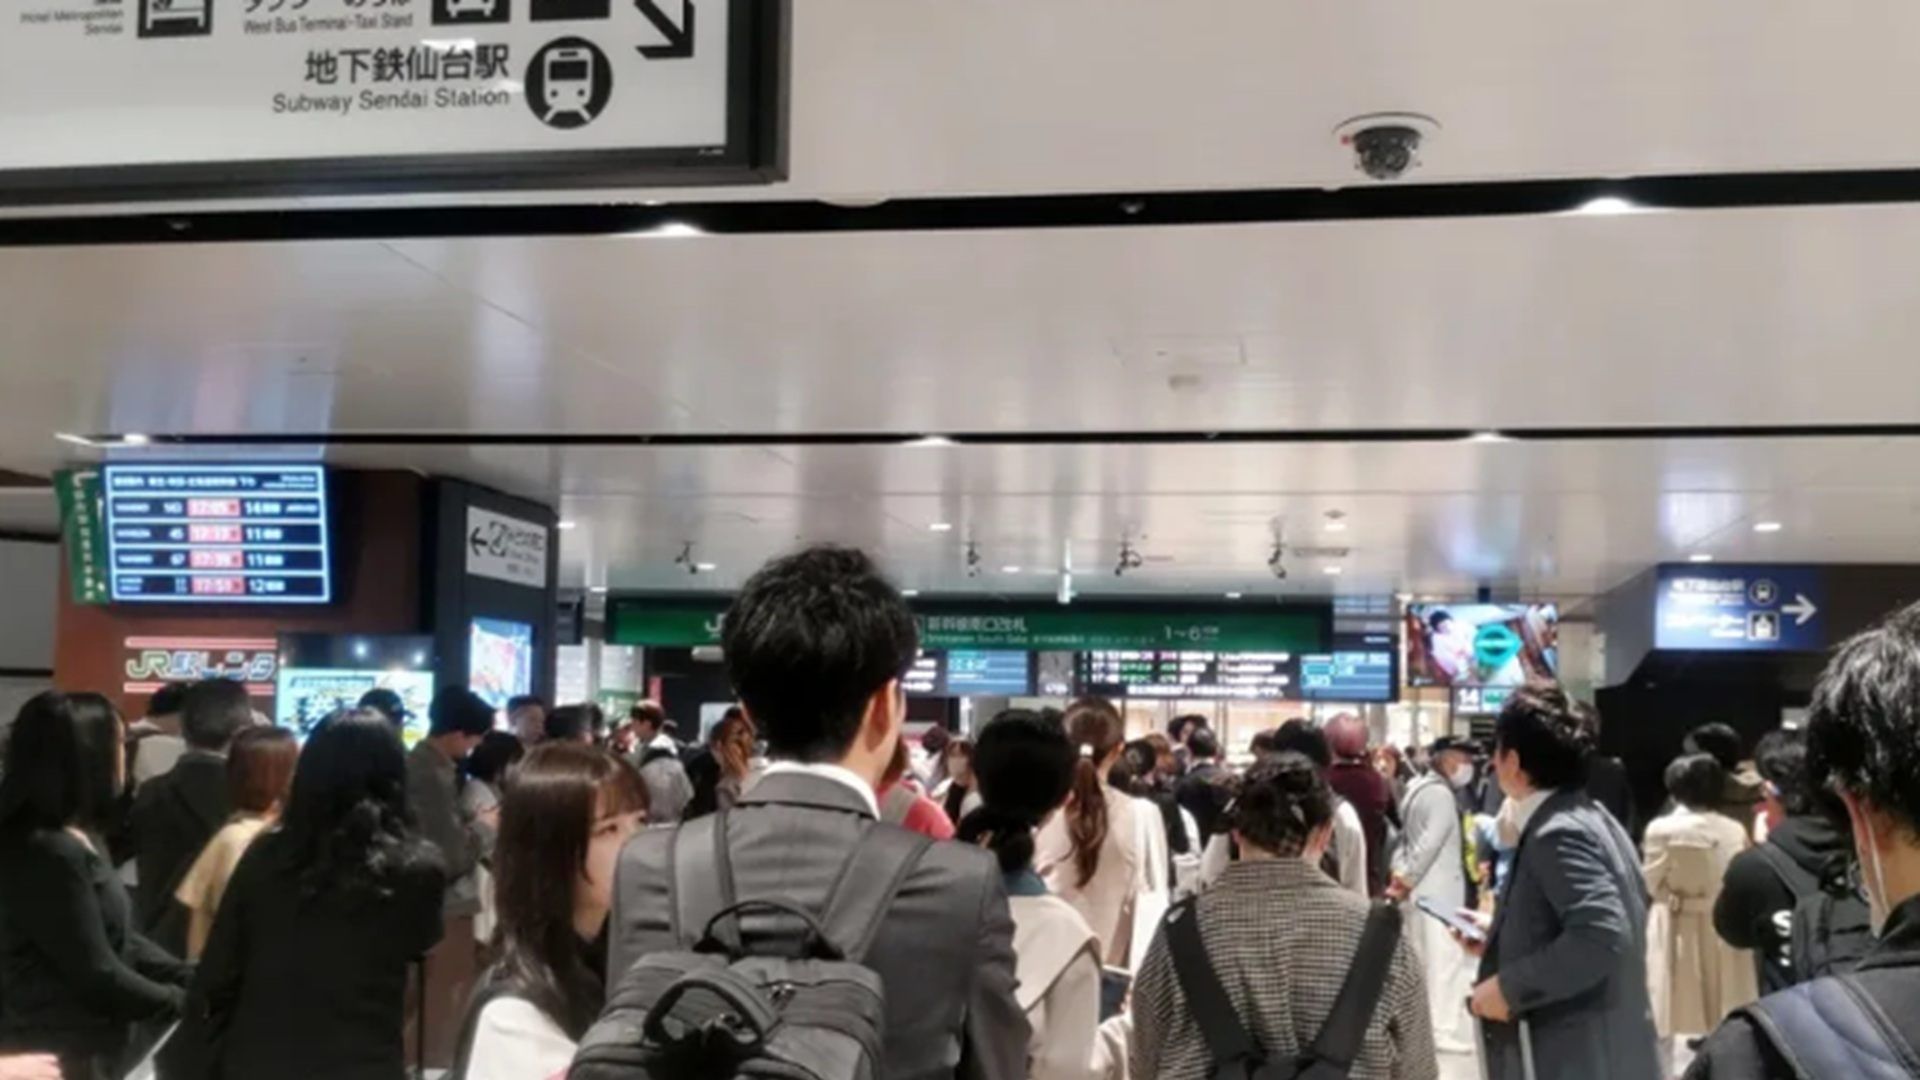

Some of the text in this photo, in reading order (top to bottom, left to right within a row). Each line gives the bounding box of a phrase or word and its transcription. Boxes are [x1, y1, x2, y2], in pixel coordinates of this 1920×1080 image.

[244, 20, 272, 34] West
[275, 17, 297, 33] Bus
[381, 13, 413, 29] Stand
[304, 44, 510, 85] 地下鉄仙台駅
[273, 87, 510, 115] Subway Sendai Station
